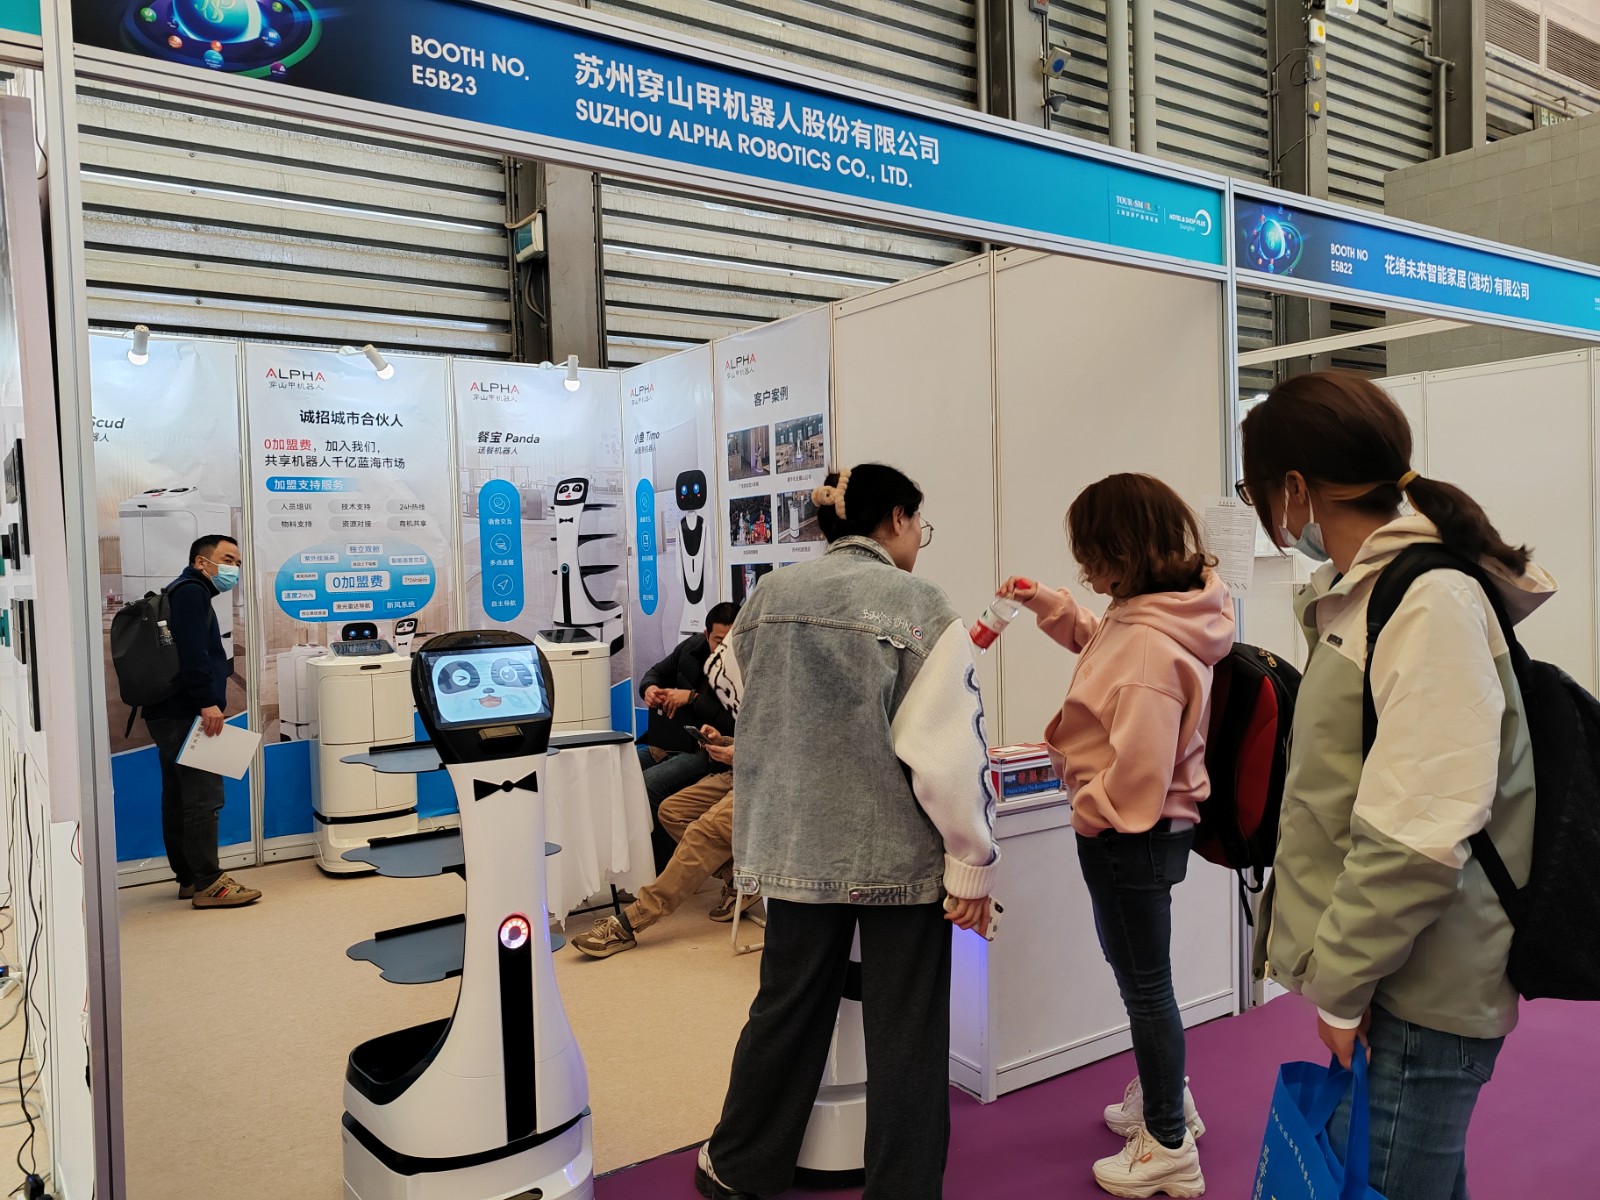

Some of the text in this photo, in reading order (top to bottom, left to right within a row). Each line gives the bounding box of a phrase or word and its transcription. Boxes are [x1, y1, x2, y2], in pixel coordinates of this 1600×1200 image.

[410, 35, 530, 82] BOOTH NO.
[411, 65, 478, 97] E5B23
[573, 51, 941, 165] 苏州穿山甲机器人股份有限公司
[575, 97, 914, 189] SUZHOU ALPHA ROBOTICS CO., LTD.
[1330, 243, 1368, 261] BOOTH NO
[1331, 260, 1353, 275] E5B22
[726, 353, 756, 371] ALPHA
[265, 367, 326, 382] ALPHA
[268, 381, 324, 391] 穿山甲机器人
[470, 382, 520, 395] ALPHA
[630, 383, 654, 398] ALPHA
[472, 394, 519, 403] 穿山甲机器人
[753, 385, 788, 407] 客户案例
[299, 409, 404, 428] 诚招城市合伙人
[477, 431, 540, 444] 餐宝 Panda
[477, 446, 518, 455] 送餐机器人
[264, 455, 405, 470] 共享机器人千亿蓝海市场
[273, 479, 345, 491] 加盟支持服务
[281, 503, 312, 511] 人员培训
[341, 503, 371, 511] 技术支持
[399, 503, 425, 511] 24h热线
[281, 520, 312, 528] 物料支持
[342, 520, 372, 528] 资源对接
[399, 520, 427, 528] 商机共享
[349, 545, 380, 554] 独立双舱
[332, 574, 383, 589] 0加盟费
[386, 601, 416, 609] 新风系统
